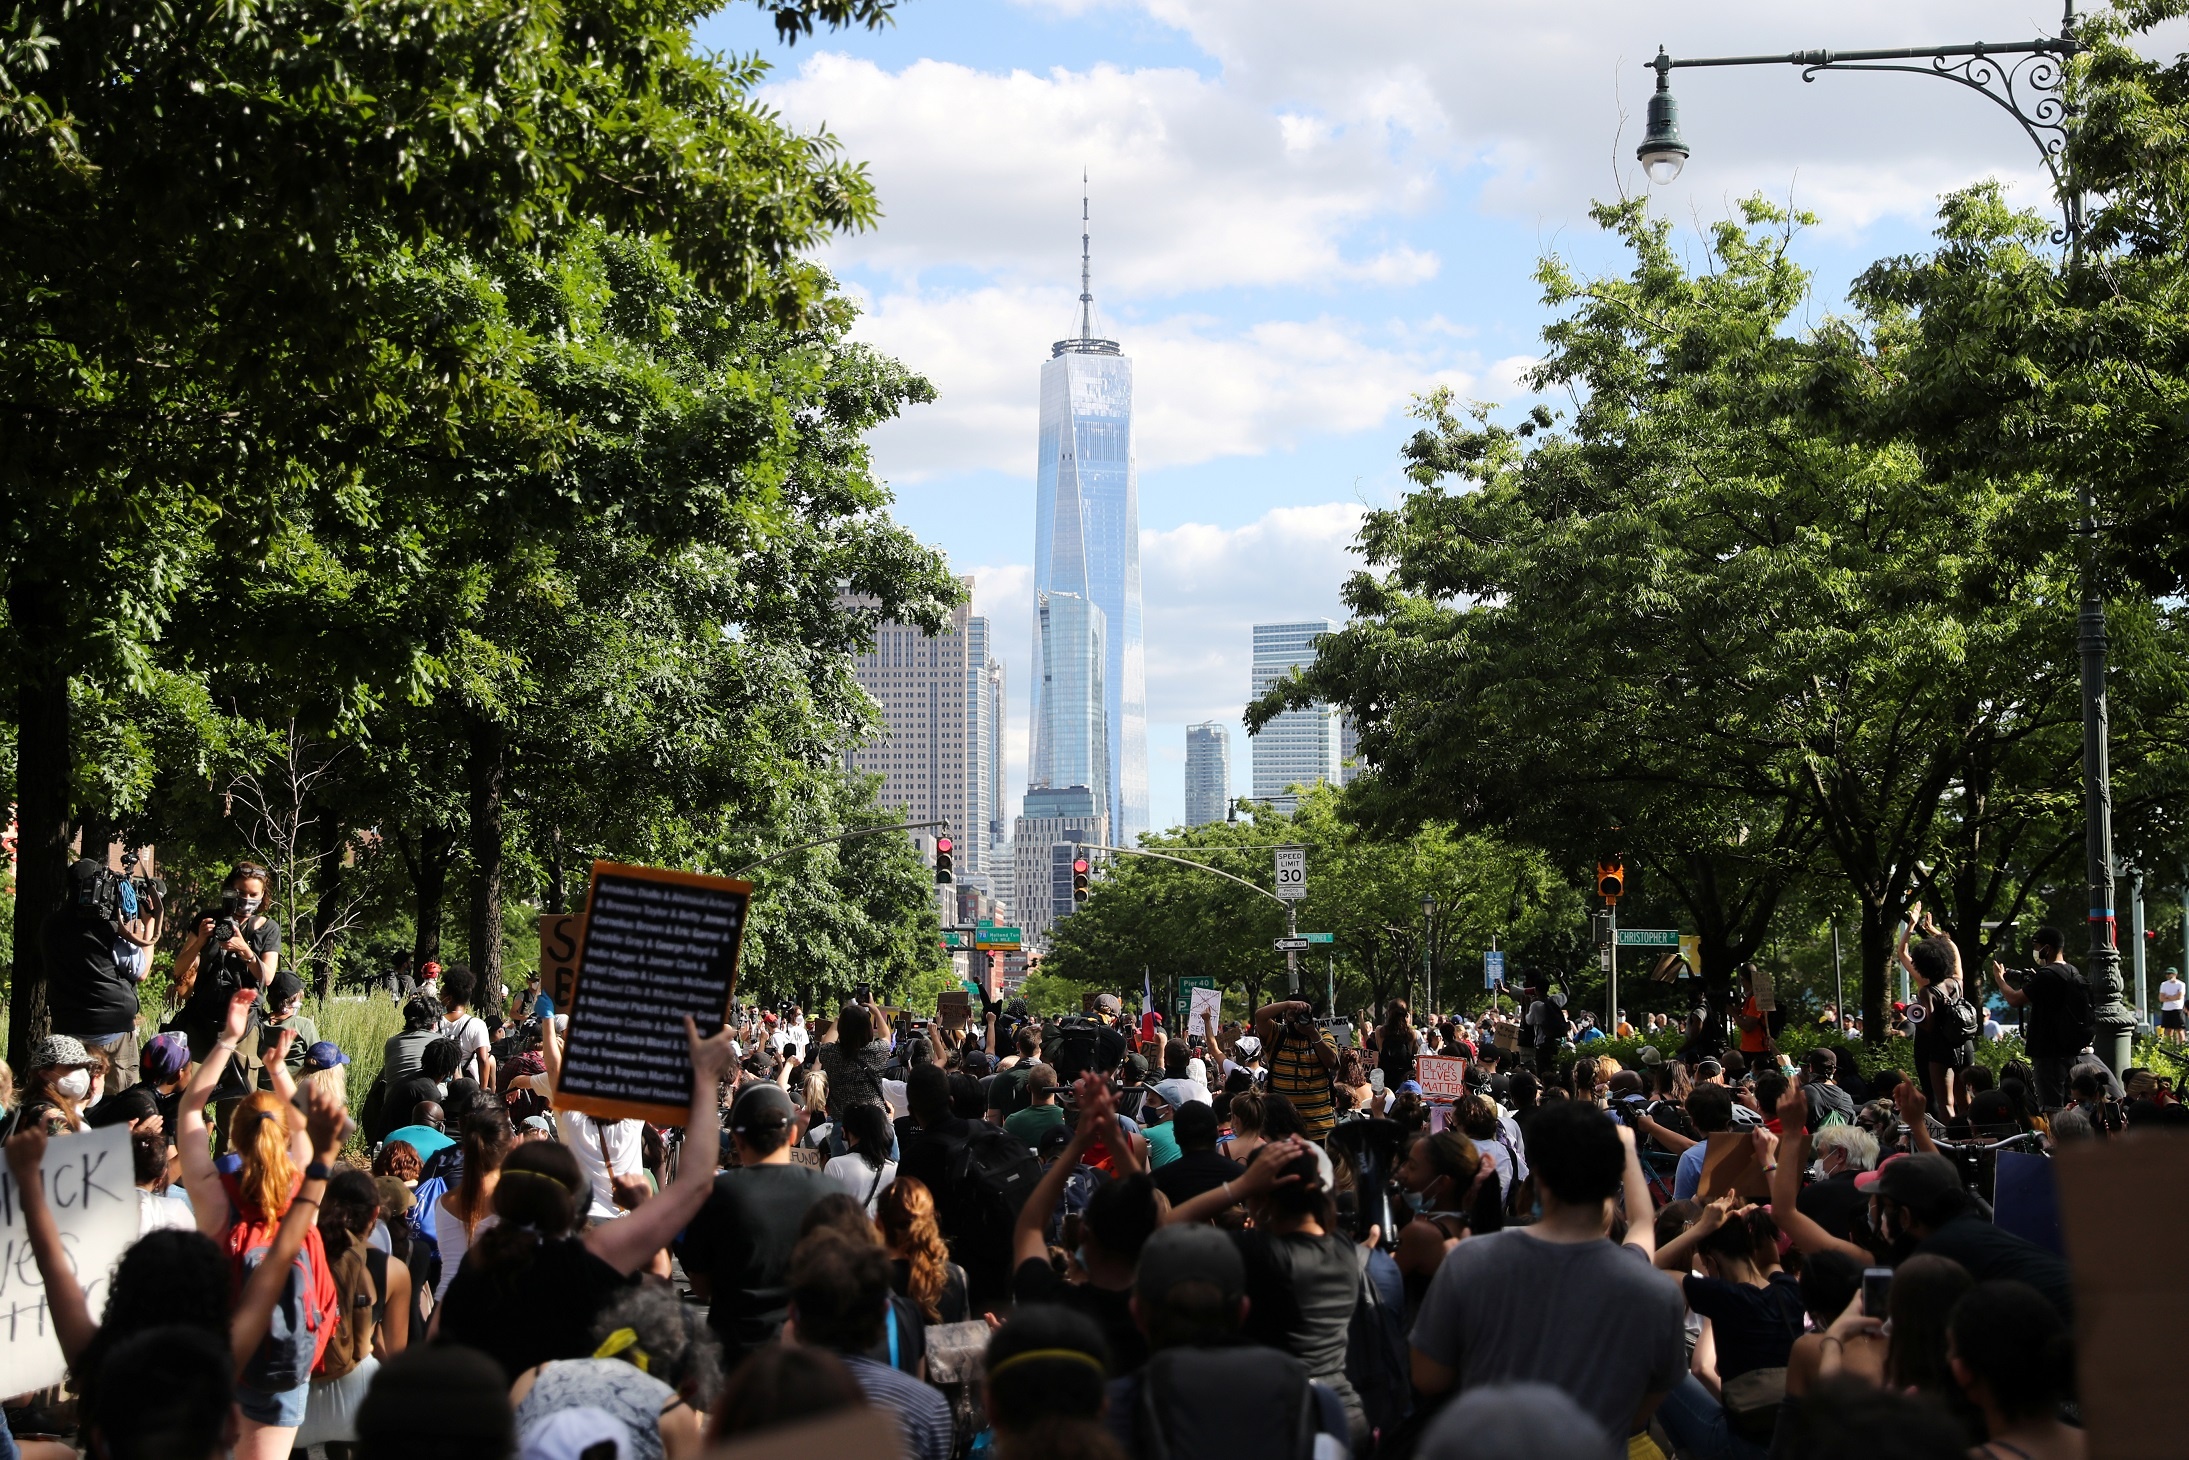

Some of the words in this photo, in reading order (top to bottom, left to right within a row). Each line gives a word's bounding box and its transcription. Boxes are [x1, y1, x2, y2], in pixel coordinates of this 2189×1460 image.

[1280, 870, 1302, 882] 30
[644, 905, 668, 918] Taylor
[636, 920, 664, 933] Brown
[674, 926, 690, 936] Eric
[693, 928, 720, 940] Garner
[1620, 932, 1667, 943] CHRISTOPHER
[626, 936, 644, 948] Gray
[656, 940, 684, 954] George
[687, 944, 710, 956] Floyd
[1178, 1001, 1186, 1011] P
[1422, 1061, 1455, 1071] BLACK
[648, 1070, 677, 1083] Martin
[1422, 1071, 1457, 1081] LIVES
[565, 1077, 592, 1090] Walter
[594, 1082, 618, 1093] Scott
